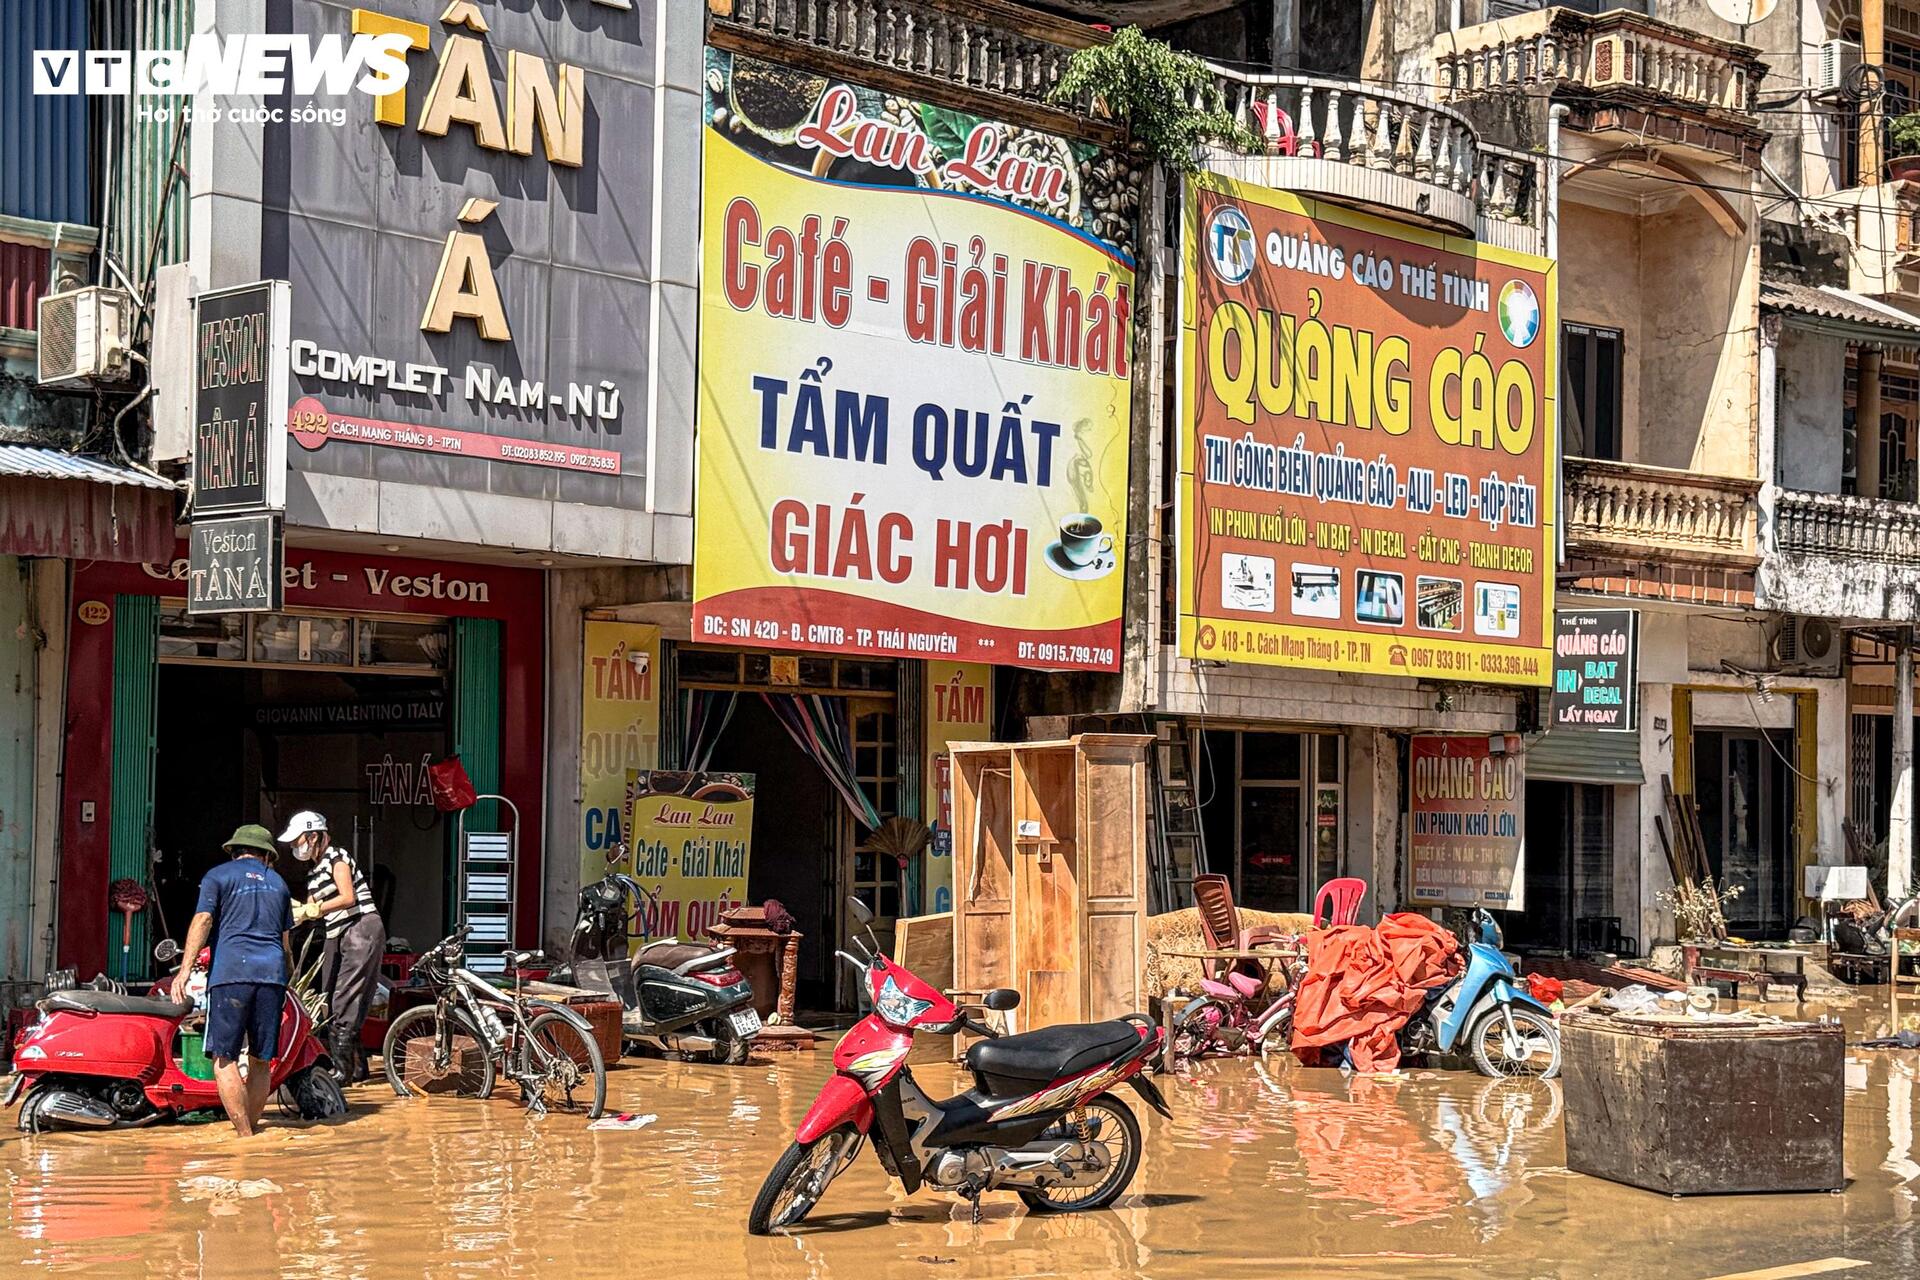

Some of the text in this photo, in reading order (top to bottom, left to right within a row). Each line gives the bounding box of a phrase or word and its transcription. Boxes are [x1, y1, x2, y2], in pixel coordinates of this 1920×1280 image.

[799, 87, 1066, 203] Lan Lan
[420, 197, 511, 342] Á
[724, 197, 852, 329] Café
[905, 235, 1007, 356] Giải
[1020, 261, 1132, 380] Khát
[1266, 233, 1489, 312] QUẢNG CÁO THẾ TÌNH
[201, 312, 265, 390] VESTON
[291, 339, 448, 395] COMPLET
[1208, 288, 1536, 454] QUẢNG CÁO
[200, 402, 259, 490] TÂN Á
[291, 410, 328, 433] 422
[332, 419, 359, 437] CÁCH
[362, 425, 391, 441] MẠNG
[394, 429, 426, 445] THÁNG
[428, 434, 434, 447] 8
[753, 357, 1060, 487] TẨM QUẤT
[1205, 437, 1229, 483] THI
[1233, 436, 1274, 489] CÔNG
[1278, 436, 1312, 495] BIỂN
[1316, 445, 1363, 502] QUẢNG
[1367, 457, 1394, 506] CÁO
[1407, 470, 1432, 512] ALU
[1445, 476, 1468, 516] LED
[1481, 474, 1505, 530] HỘP
[1509, 478, 1534, 525] ĐÈN
[201, 529, 256, 555] Veston
[771, 492, 1028, 595] GIÁC HƠI
[1211, 508, 1223, 535] IN
[1226, 510, 1256, 540] PHUN
[1260, 506, 1282, 543] KHỔ
[1285, 512, 1306, 545] LỚN
[1316, 522, 1328, 548] IN
[1331, 524, 1350, 557] BẠT
[1360, 527, 1371, 555] IN
[1375, 530, 1406, 558] DECAL
[1419, 526, 1437, 562] CẮT
[1440, 538, 1460, 565] CNC
[1469, 542, 1500, 569] TRANH
[1502, 545, 1533, 573] DECOR
[364, 568, 489, 602] Veston
[82, 605, 108, 620] 422
[1561, 616, 1597, 625] THẾ TÌNH
[704, 615, 728, 636] ĐC:
[731, 617, 751, 638] SN
[754, 620, 779, 640] 420
[791, 623, 805, 642] Đ.
[808, 625, 844, 645] CMT8
[856, 628, 873, 647] TP.
[877, 628, 904, 650] THÁI
[908, 631, 957, 653] NGUYÊN
[1018, 641, 1036, 659] ĐT:
[1038, 643, 1113, 664] 0915.799.749
[1222, 630, 1238, 651] 418
[1246, 632, 1255, 653] Đ.
[1258, 633, 1279, 655] Cách
[1281, 635, 1304, 661] Mạng
[1307, 637, 1331, 662] Tháng
[1334, 641, 1339, 659] 8
[1346, 641, 1358, 662] TP.
[1360, 643, 1371, 663] TN
[1411, 648, 1433, 667] 0967
[1437, 650, 1453, 669] 933
[1456, 652, 1471, 671] 911
[1481, 654, 1538, 676] 0333.396.444
[1556, 627, 1625, 657] QUẢNG CÁO
[592, 641, 652, 700] TẨM
[1557, 670, 1576, 693] IN
[1584, 687, 1622, 704] DECAL
[256, 702, 444, 723] GIOVANNI VALENTINO ITALY
[934, 670, 984, 723] TẨM
[1559, 705, 1618, 722] LẤY NGAY
[366, 753, 412, 804] TÂN
[1416, 742, 1474, 803] QUẢNG
[653, 803, 735, 825] Lan Lan
[1415, 804, 1516, 836] IN PHUN KHỔ LỚN
[682, 836, 710, 878] Giải
[713, 840, 746, 878] Khát
[634, 885, 680, 937] TẨM
